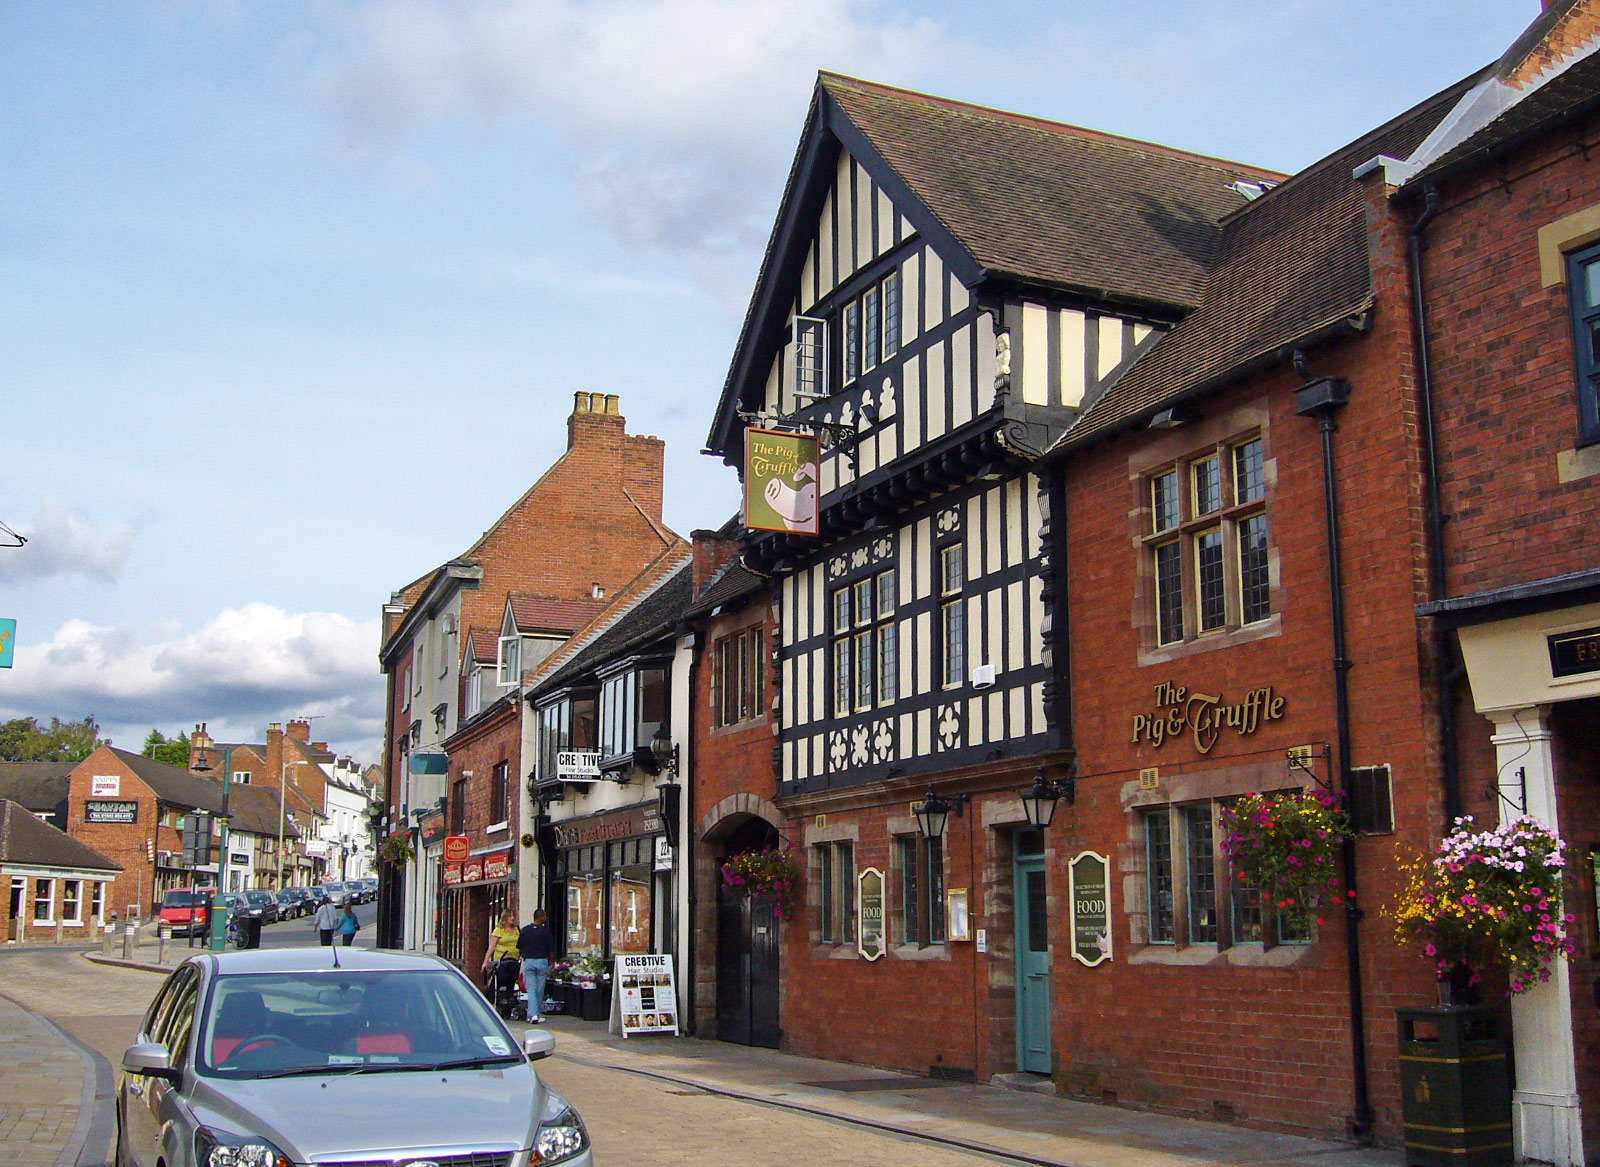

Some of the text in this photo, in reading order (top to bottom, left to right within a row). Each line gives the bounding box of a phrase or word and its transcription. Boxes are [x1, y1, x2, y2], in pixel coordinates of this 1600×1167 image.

[753, 443, 774, 455] The
[775, 446, 794, 460] Pig
[751, 456, 798, 477] Truffle
[1154, 680, 1187, 708] The
[1131, 687, 1286, 754] Pig & Truffle
[559, 754, 602, 767] CRETIVE
[863, 907, 881, 918] FOOD
[1076, 900, 1105, 914] FOOD
[625, 956, 666, 967] CRE8TIVE
